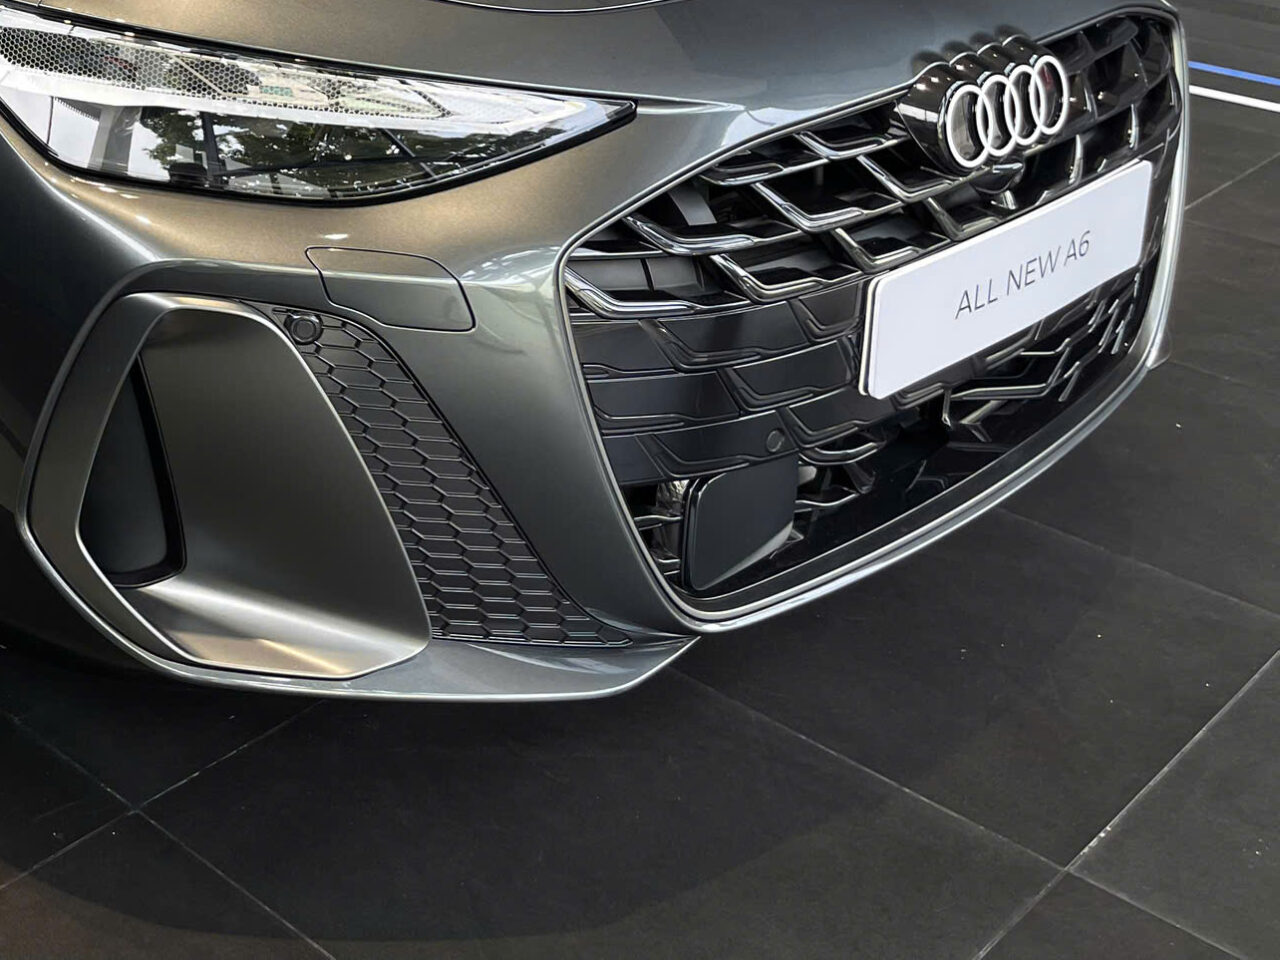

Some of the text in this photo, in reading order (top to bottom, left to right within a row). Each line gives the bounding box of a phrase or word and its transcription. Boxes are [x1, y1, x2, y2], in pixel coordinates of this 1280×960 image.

[955, 229, 1091, 320] ALL NEW A6
